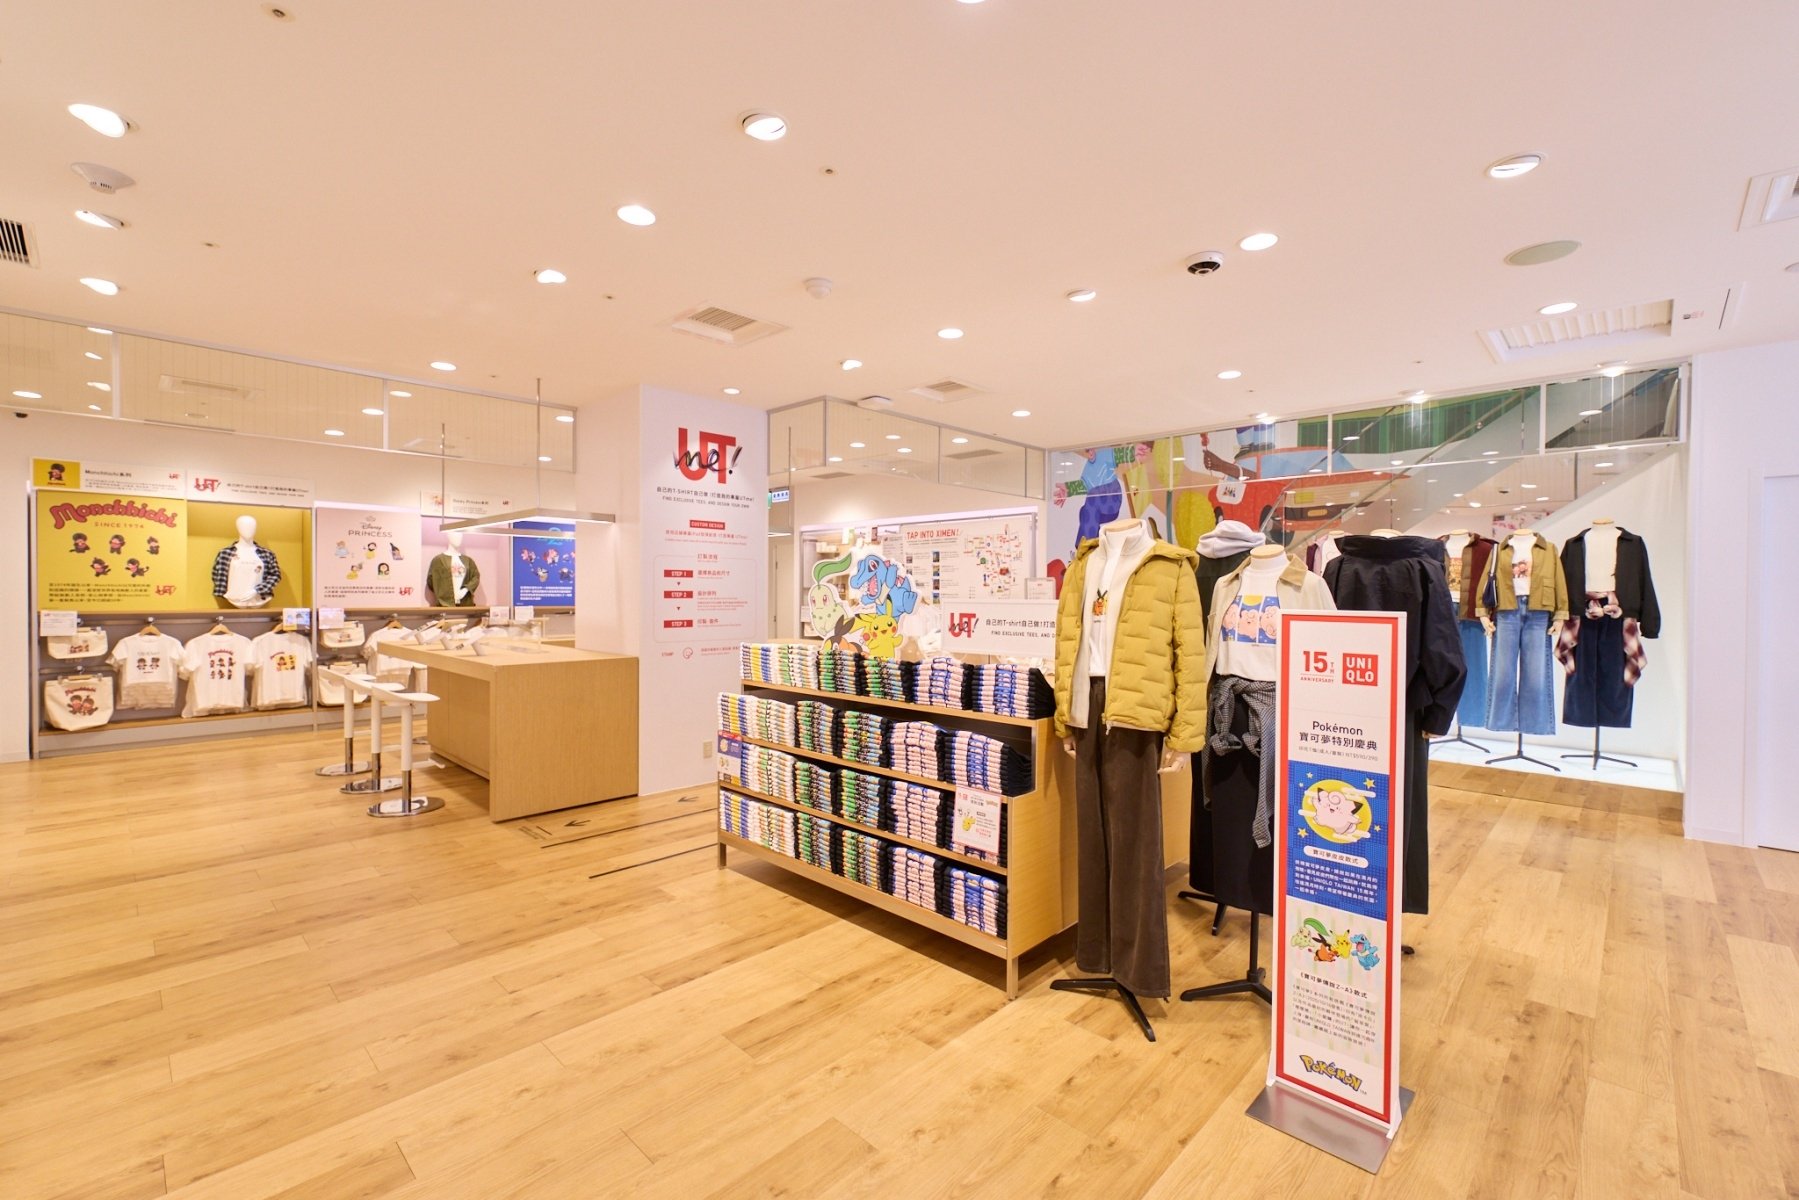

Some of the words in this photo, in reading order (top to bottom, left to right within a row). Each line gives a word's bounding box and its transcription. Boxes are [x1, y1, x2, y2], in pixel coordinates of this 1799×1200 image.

[679, 428, 736, 484] UT
[49, 499, 178, 529] Monchhichi
[907, 532, 918, 540] TAP
[936, 529, 959, 537] XIMEN!
[950, 612, 976, 638] UT
[1303, 651, 1328, 673] 15
[1312, 720, 1363, 736] Pokémon
[1300, 731, 1377, 750] 寶可夢特別慶典
